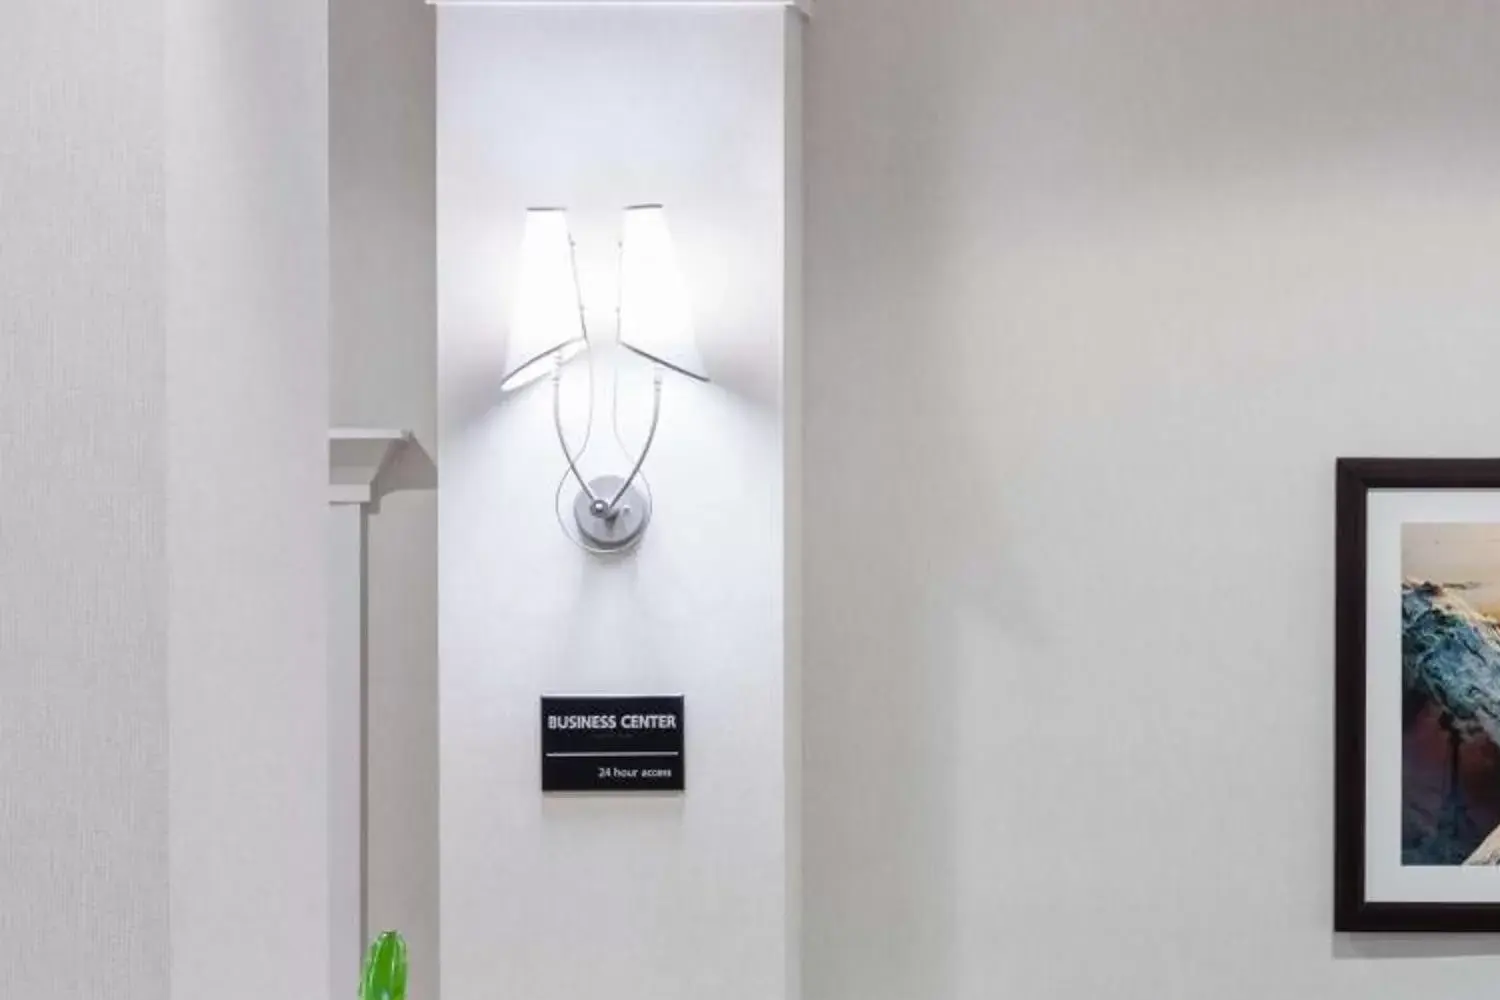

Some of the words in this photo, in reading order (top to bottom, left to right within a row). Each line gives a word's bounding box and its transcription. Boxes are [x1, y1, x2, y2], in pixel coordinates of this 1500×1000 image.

[547, 714, 617, 729] BUSINESS
[620, 714, 677, 729] CENTER
[598, 767, 611, 777] 24
[613, 767, 638, 777] hour
[641, 769, 672, 777] access
